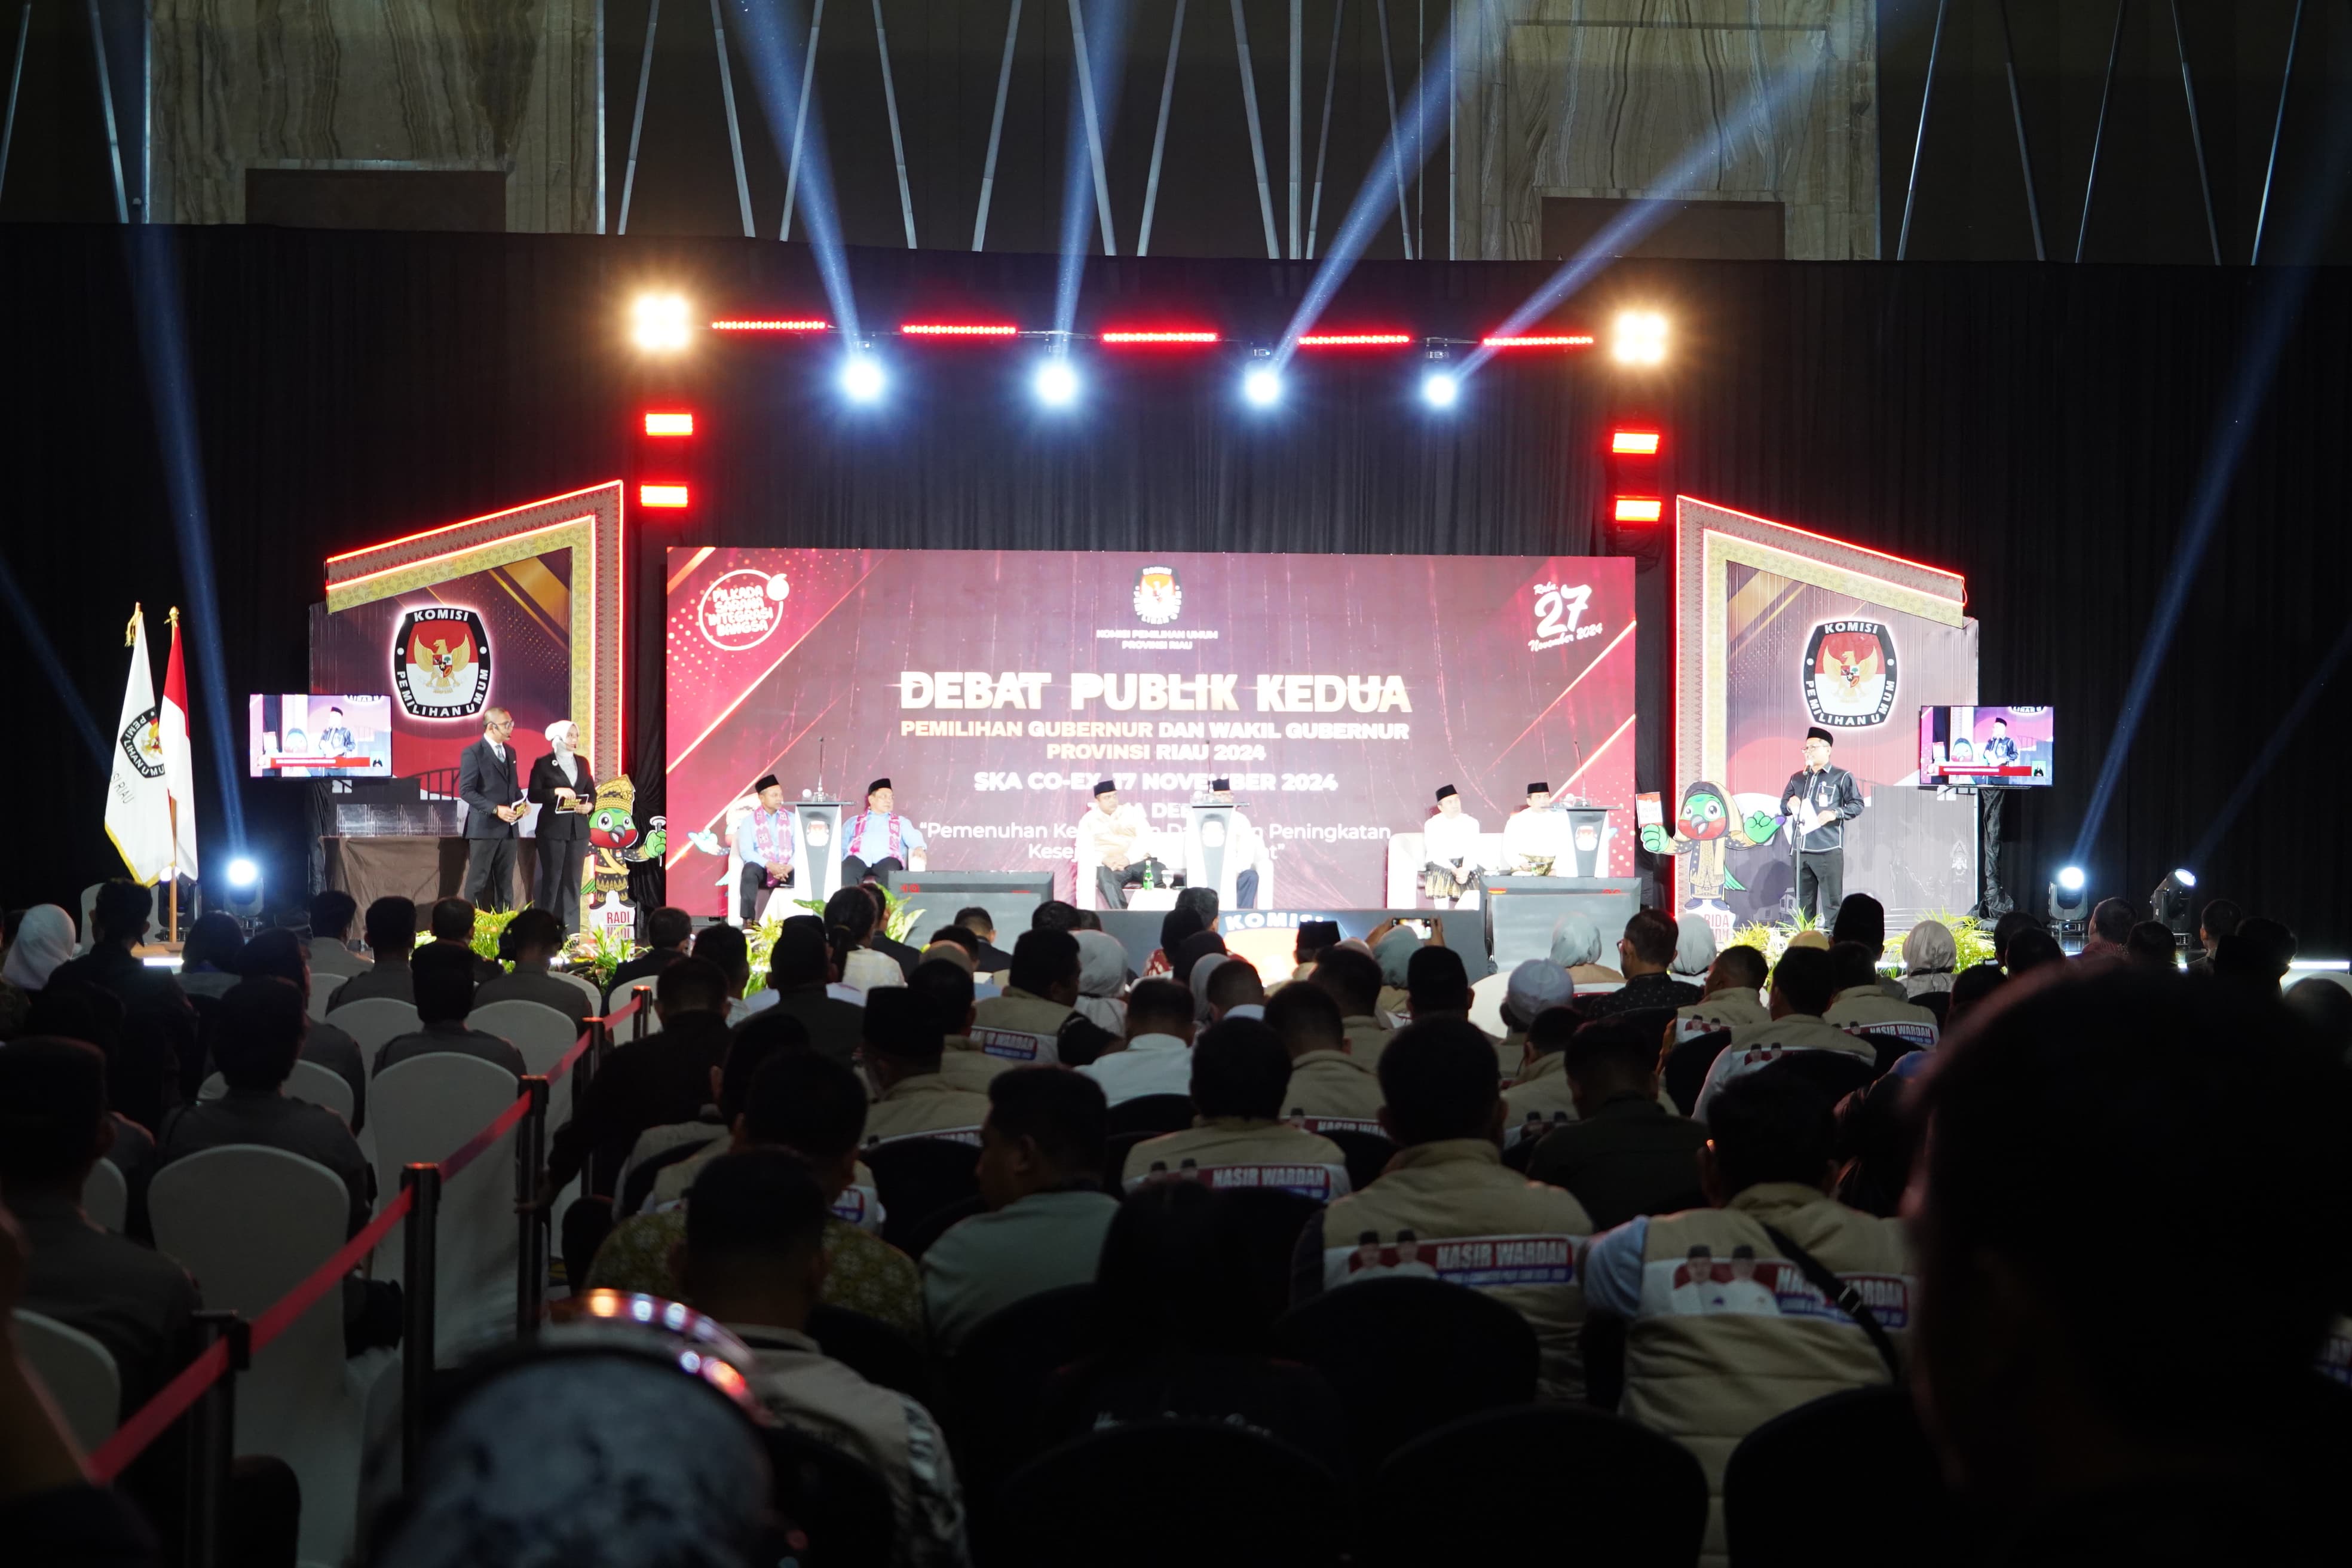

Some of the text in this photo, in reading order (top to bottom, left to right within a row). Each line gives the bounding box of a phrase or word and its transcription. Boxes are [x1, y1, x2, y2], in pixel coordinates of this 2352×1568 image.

[414, 609, 469, 622] KOMISI
[1535, 584, 1592, 638] 27
[1576, 623, 1603, 640] 2024
[1824, 621, 1878, 634] KOMISI
[397, 669, 489, 716] PEMILIHAN UMUM
[901, 671, 1413, 712] DEBAT PUBLIK KEDUA
[1805, 680, 1895, 725] PEMILIHAN UMUM
[901, 721, 1410, 740] PEMILIHAN GUBERNUR DAN WAKIL GUBERNUR
[1046, 744, 1266, 761] PROVINSI RIAU 2024
[141, 764, 164, 777] UMU
[974, 771, 1023, 791] SKA
[1112, 773, 1137, 791] 17
[1281, 773, 1339, 791] 2024
[1269, 822, 1391, 843] Peningkatan
[607, 911, 630, 924] RADI
[1897, 1025, 1931, 1038] WARDAN
[1212, 1167, 1325, 1187] NASIR WARDAN
[1436, 1241, 1569, 1270] NASIR WARDAN
